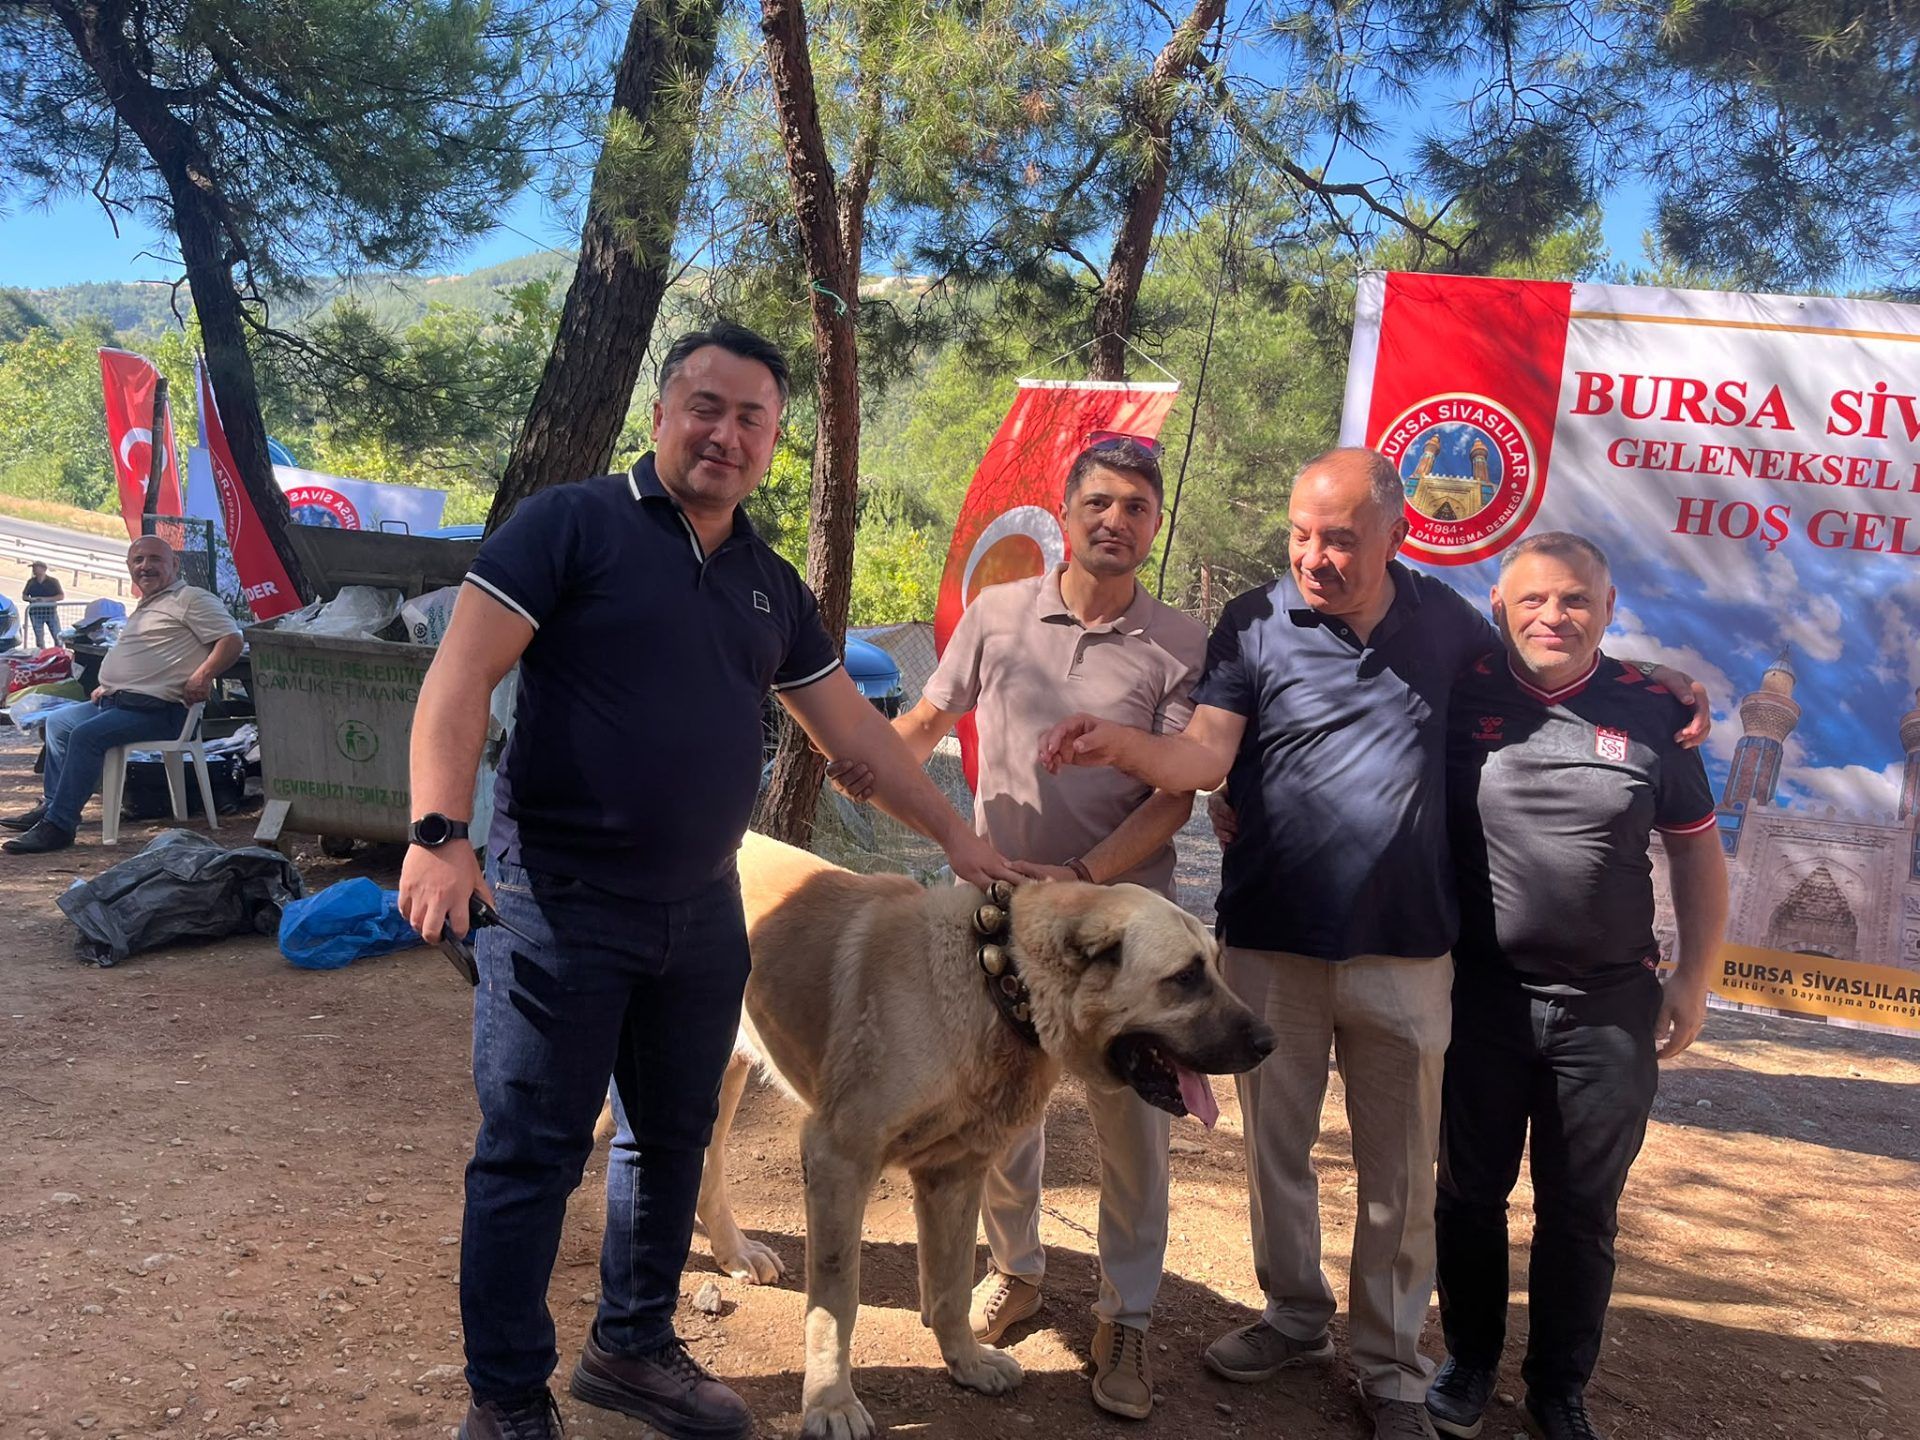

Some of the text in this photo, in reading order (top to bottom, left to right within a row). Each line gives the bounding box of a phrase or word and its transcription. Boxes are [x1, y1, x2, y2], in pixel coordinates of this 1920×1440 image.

[1569, 371, 1795, 431] BURSA
[1438, 402, 1527, 478] SİVASLILAR
[1607, 437, 1900, 491] GELENEKSEL
[1415, 529, 1484, 546] DAYANIŞMA
[1428, 522, 1457, 535] 1984
[1670, 496, 1791, 552] HOŞ
[1722, 977, 1766, 993] Kültür
[1771, 987, 1785, 996] ve
[1791, 988, 1863, 1008] Dayanışma
[1723, 960, 1794, 985] BURSA
